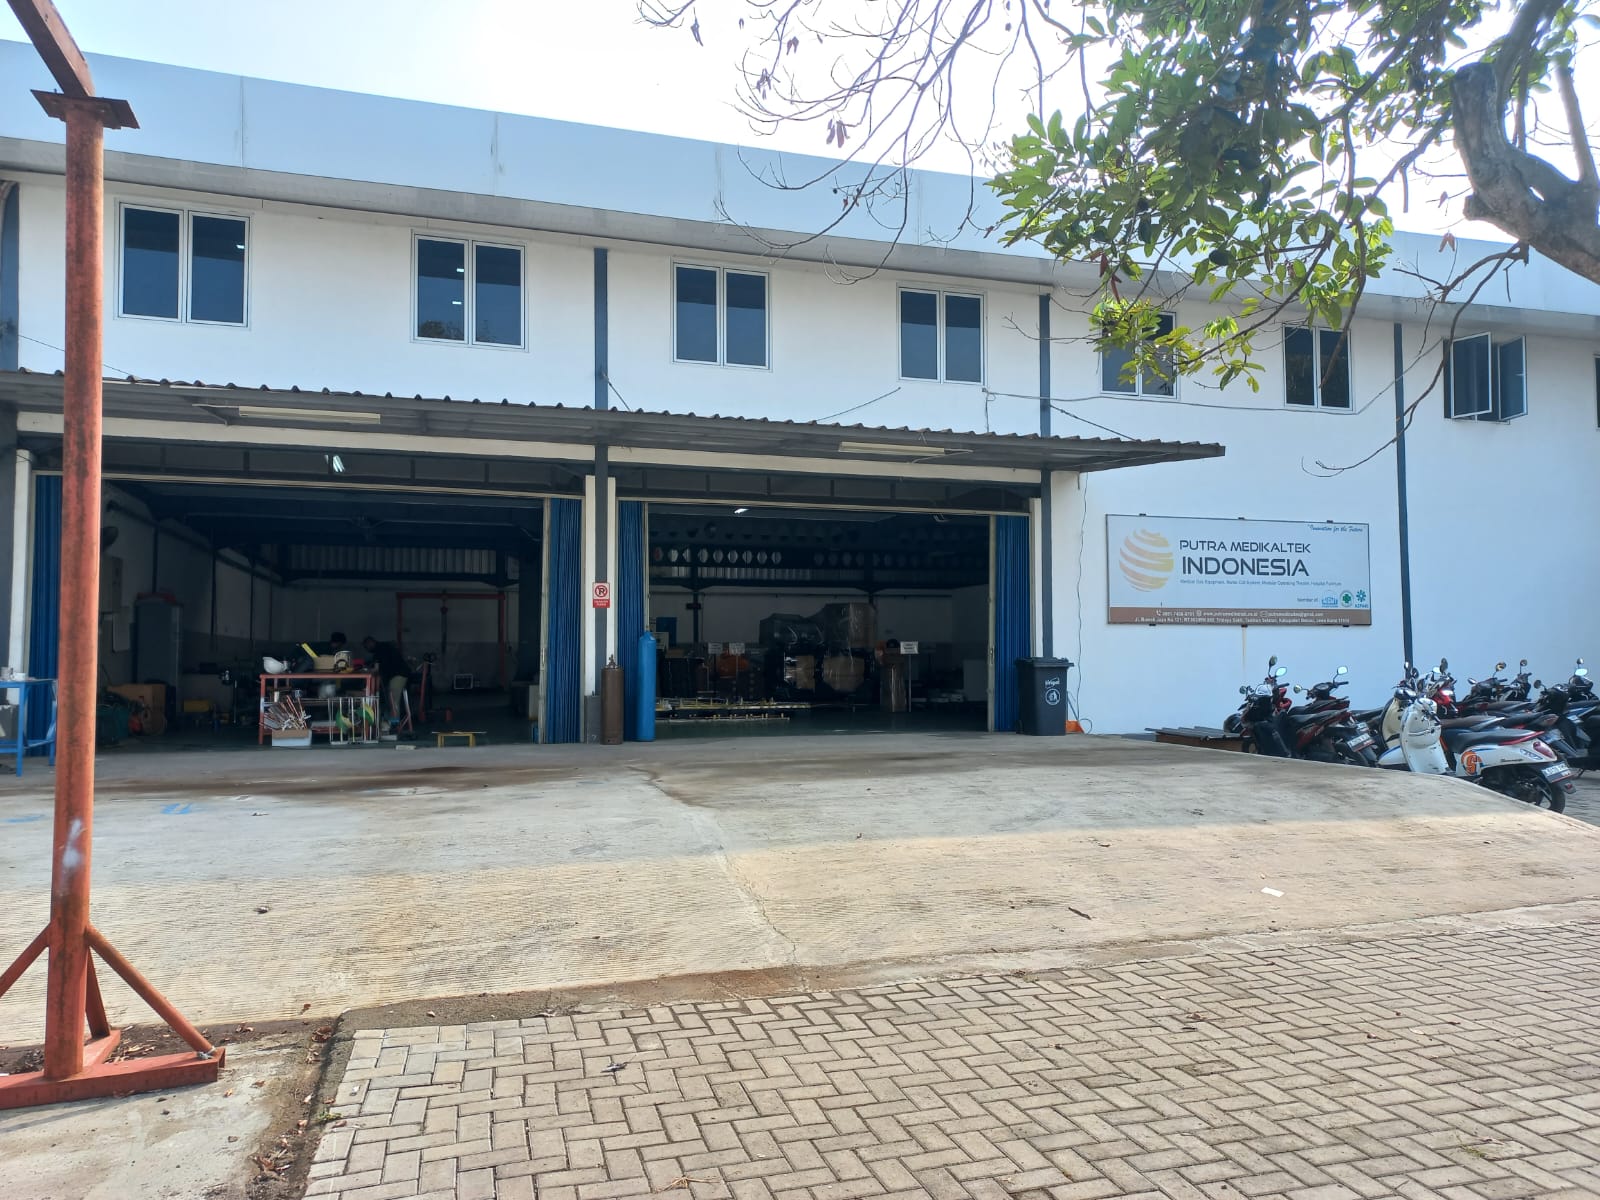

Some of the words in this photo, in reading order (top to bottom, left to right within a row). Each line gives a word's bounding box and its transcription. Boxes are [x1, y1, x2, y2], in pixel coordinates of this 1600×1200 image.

[1179, 540, 1227, 551] PUTRA
[1230, 541, 1311, 553] MEDIKALTEK
[1182, 556, 1310, 577] INDONESIA
